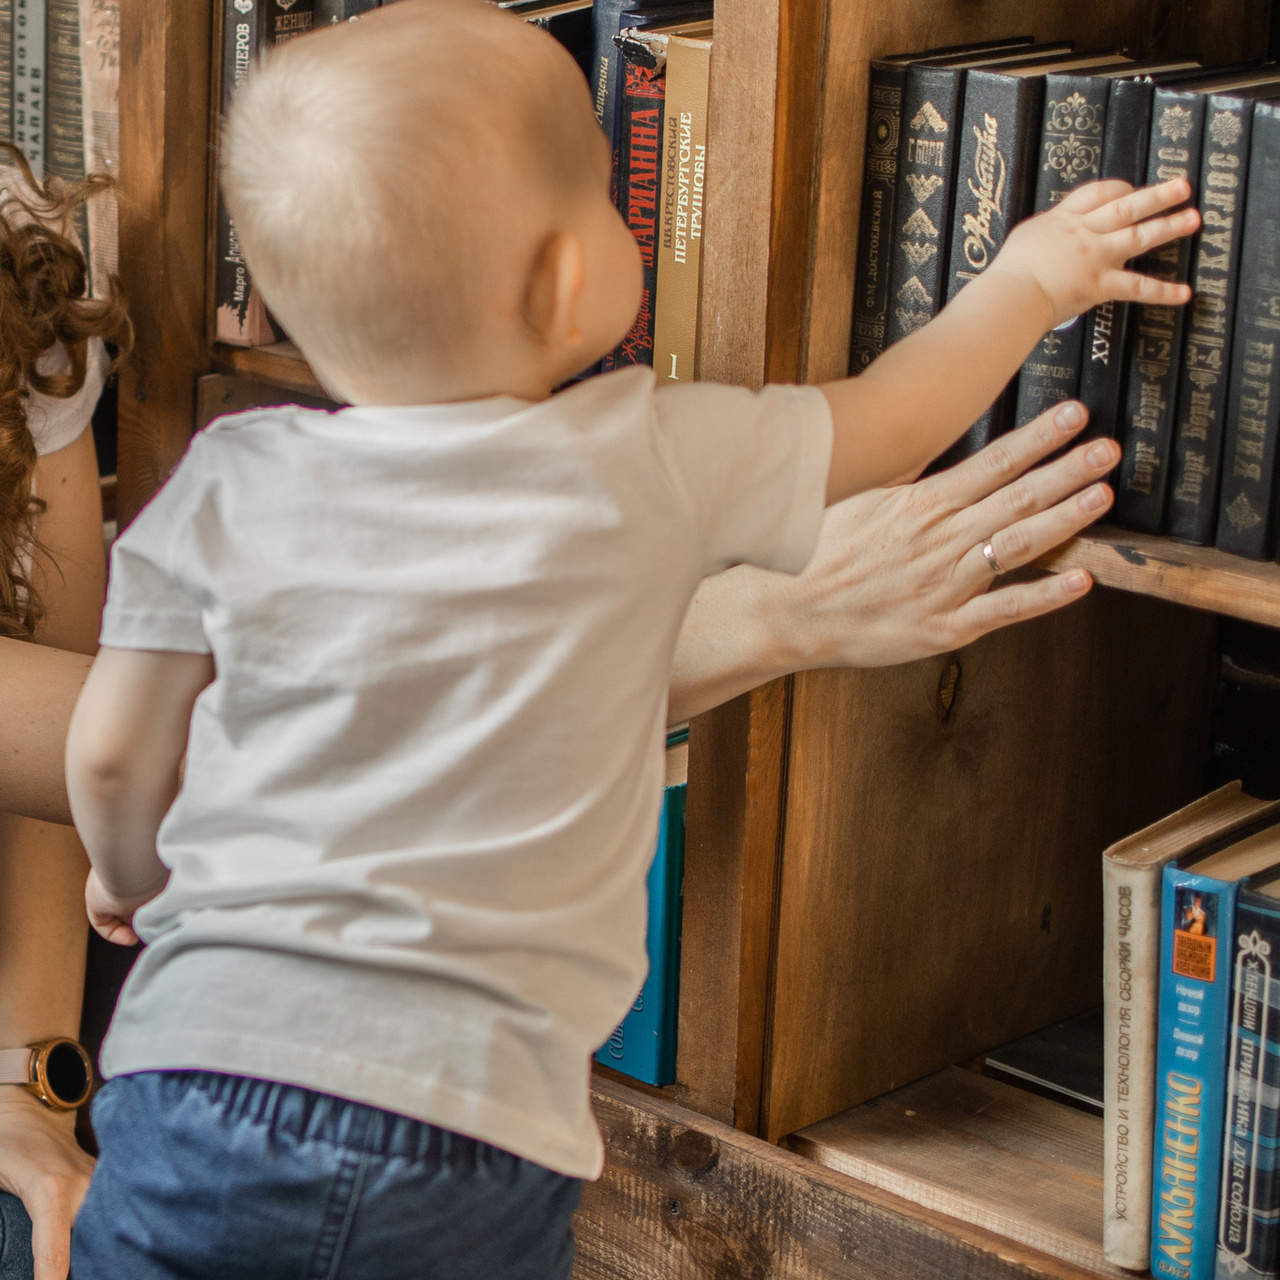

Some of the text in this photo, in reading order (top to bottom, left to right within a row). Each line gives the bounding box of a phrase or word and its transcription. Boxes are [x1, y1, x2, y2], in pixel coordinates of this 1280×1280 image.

[28, 68, 41, 162] ЧАПАЕВ
[593, 56, 609, 126] Авиценна
[674, 111, 692, 264] ПЕТЕРБУРГСКИЕ
[867, 189, 884, 282] ДОСТОЕВСКИЙ
[234, 267, 247, 301] Марго
[1092, 299, 1115, 365] ХУНН
[1138, 339, 1171, 361] 1-2
[1187, 344, 1223, 370] 3-4
[668, 353, 679, 380] 1
[1233, 339, 1276, 483] ЕВГЕНИЯ
[1114, 886, 1132, 1221] УСТРОЙСТВО И ТЕХНОЛОГИЯ СБОРКИ ЧАСОВ
[1159, 1071, 1203, 1267] ЛУКЬЯНЕНКО
[1231, 1140, 1247, 1180] для
[1228, 1179, 1245, 1245] сокола
